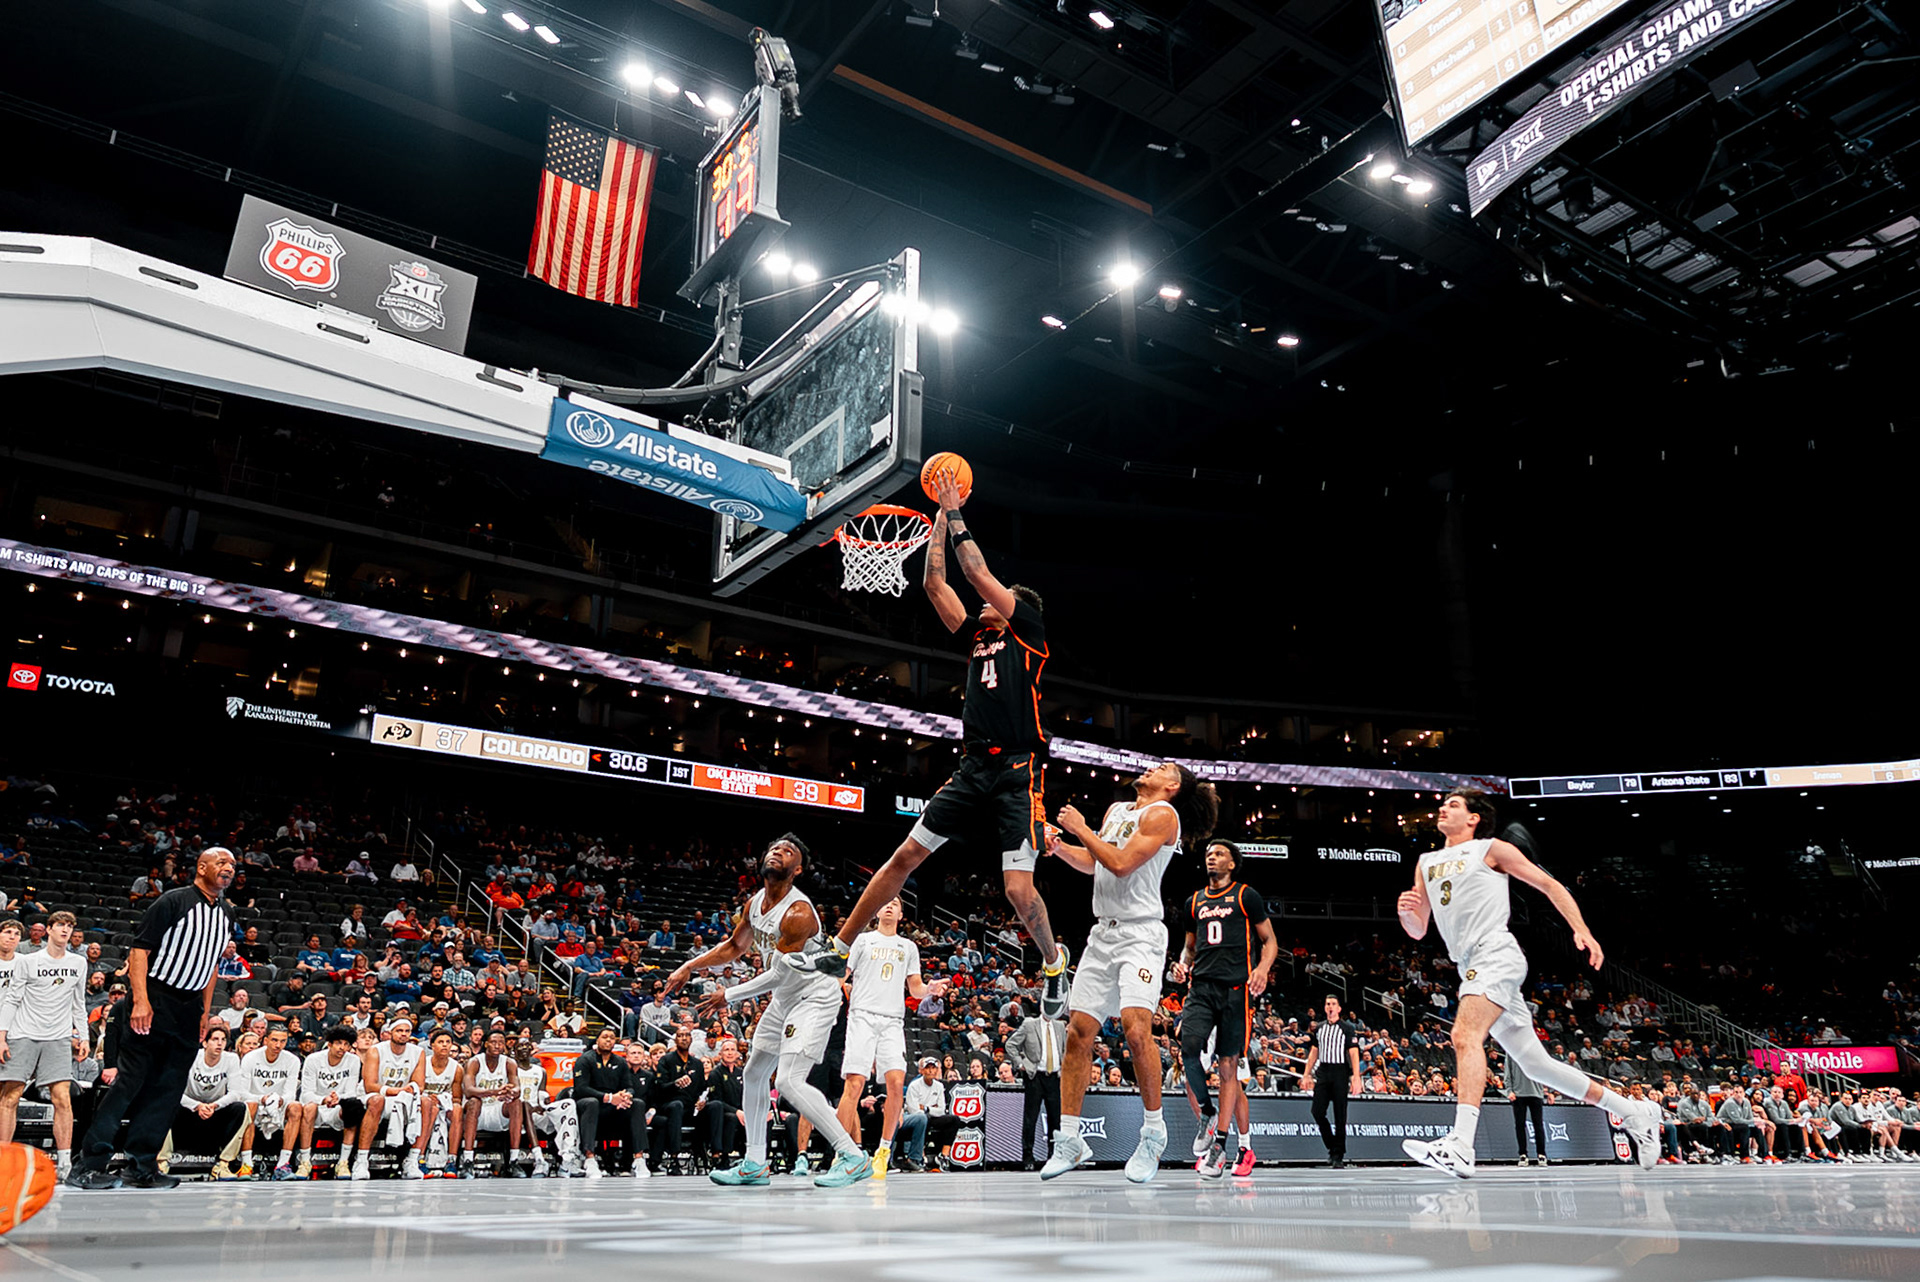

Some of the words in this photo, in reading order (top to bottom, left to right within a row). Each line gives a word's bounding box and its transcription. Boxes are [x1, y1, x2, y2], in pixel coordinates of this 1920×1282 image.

[1582, 42, 1672, 114] T-SHIRTS
[1678, 10, 1723, 52] AND
[1560, 40, 1640, 107] OFFICIAL
[279, 228, 333, 256] PHILLIPS
[275, 248, 325, 278] 66
[389, 270, 442, 309] XII
[615, 432, 718, 480] Allstate
[16, 550, 68, 570] T-SHIRTS
[69, 561, 94, 575] AND
[96, 566, 126, 580] CAPS
[129, 572, 144, 583] OF
[145, 574, 168, 588] THE
[169, 579, 188, 592] BIG
[192, 583, 206, 596] 12
[981, 659, 998, 688] 4
[46, 674, 116, 696] TOYOTA
[244, 710, 274, 721] KANSAS
[274, 714, 303, 726] HEALTH
[304, 719, 331, 730] SYSTEM
[246, 703, 261, 712] THE
[263, 706, 308, 720] UNIVERSITY
[436, 728, 468, 751] 37
[483, 736, 586, 766] COLORADO
[609, 752, 648, 773] 30.6
[672, 766, 690, 779] 1ST
[706, 768, 772, 788] OKLAHOMA
[721, 780, 756, 795] STATE
[793, 782, 818, 802] 39
[1567, 781, 1596, 792] Baylor
[1652, 777, 1684, 787] Arizona
[1686, 776, 1710, 786] State
[1724, 774, 1738, 784] 83
[1772, 773, 1781, 782] 0
[1886, 772, 1894, 781] 6
[1328, 848, 1362, 860] Mobile
[1363, 852, 1398, 862] CENTER
[1440, 880, 1452, 906] 3
[1207, 920, 1222, 945] 0
[872, 948, 904, 962] BUFFS
[38, 968, 59, 977] LOCK
[61, 968, 68, 976] IT
[880, 962, 894, 982] 0
[1802, 1052, 1863, 1069] Mobile
[194, 1072, 212, 1084] LOCK
[212, 1072, 220, 1083] IT
[254, 1068, 270, 1079] LOCK
[272, 1070, 279, 1079] IT
[280, 1069, 288, 1078] IN
[318, 1071, 335, 1081] LOCK
[336, 1071, 342, 1080] IT
[956, 1099, 978, 1114] 66
[1250, 1123, 1298, 1136] AMPIONSHIP
[1300, 1124, 1320, 1136] LOCK
[1354, 1124, 1388, 1136] T-SHIRTS
[1389, 1125, 1404, 1136] AND
[1405, 1125, 1424, 1136] CAPS
[1424, 1125, 1434, 1136] OF
[1434, 1125, 1448, 1136] THE
[182, 1154, 214, 1163] Allstate
[955, 1144, 977, 1158] 66
